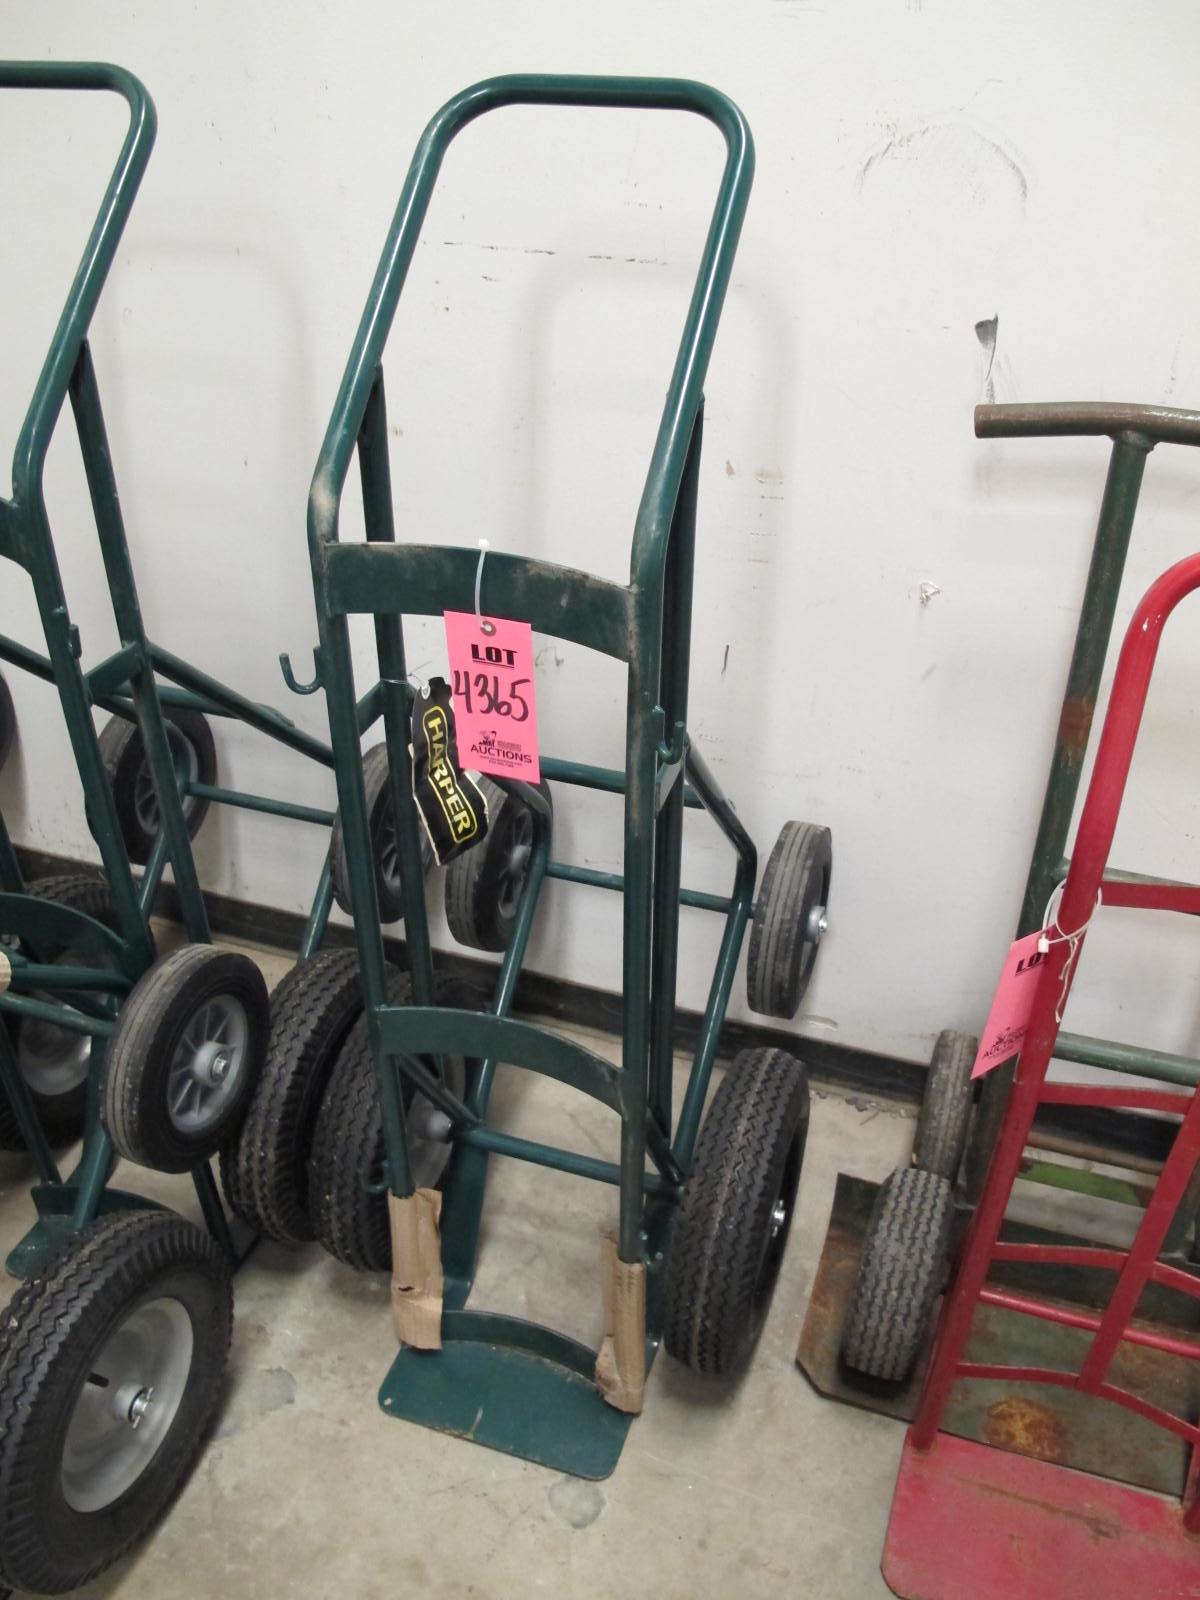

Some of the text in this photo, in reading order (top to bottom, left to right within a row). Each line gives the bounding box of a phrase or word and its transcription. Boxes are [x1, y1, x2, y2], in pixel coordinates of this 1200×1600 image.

[471, 643, 518, 667] LOT
[454, 670, 531, 722] 4365
[470, 744, 532, 764] AUCTIONS
[427, 716, 471, 834] HARPER
